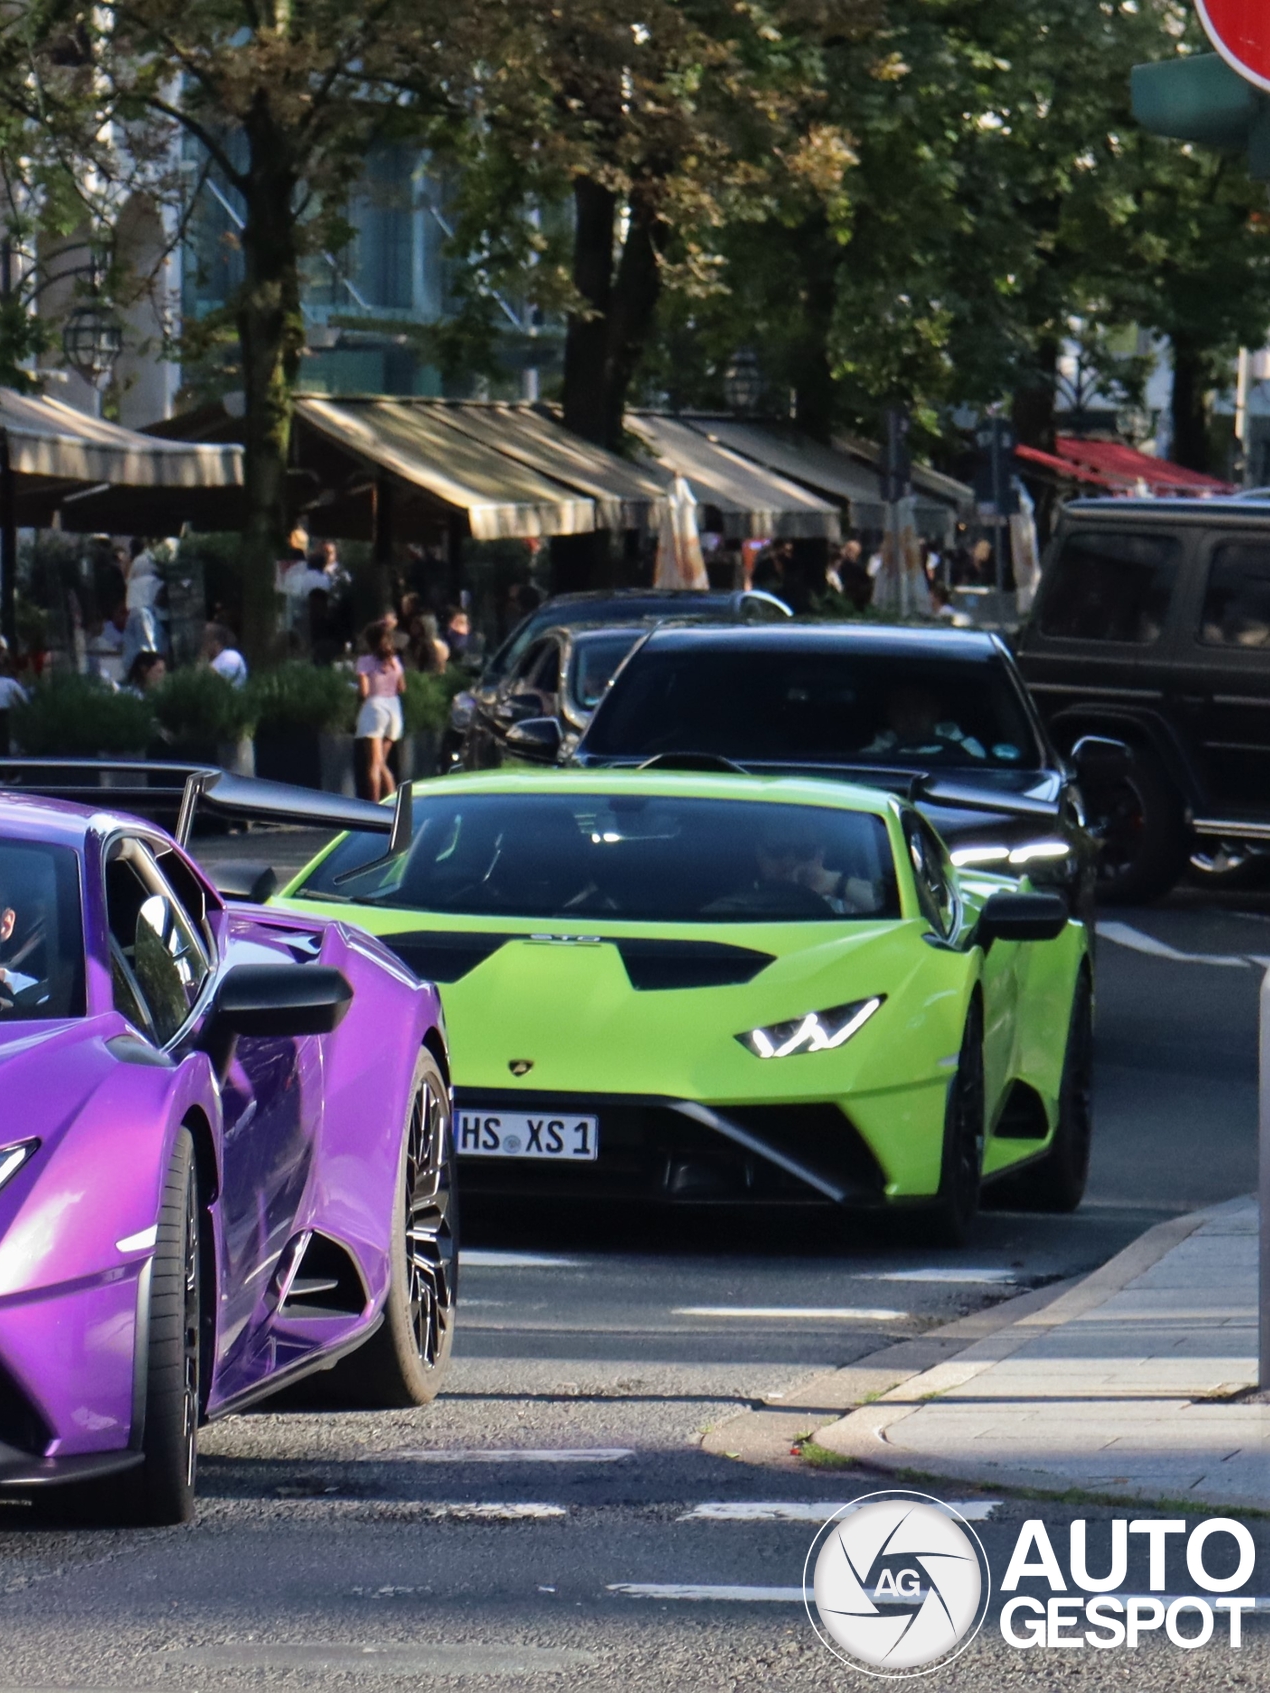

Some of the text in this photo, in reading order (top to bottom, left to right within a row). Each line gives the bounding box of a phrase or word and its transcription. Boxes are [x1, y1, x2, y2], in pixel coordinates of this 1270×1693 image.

[461, 1116, 591, 1155] HS XS 1
